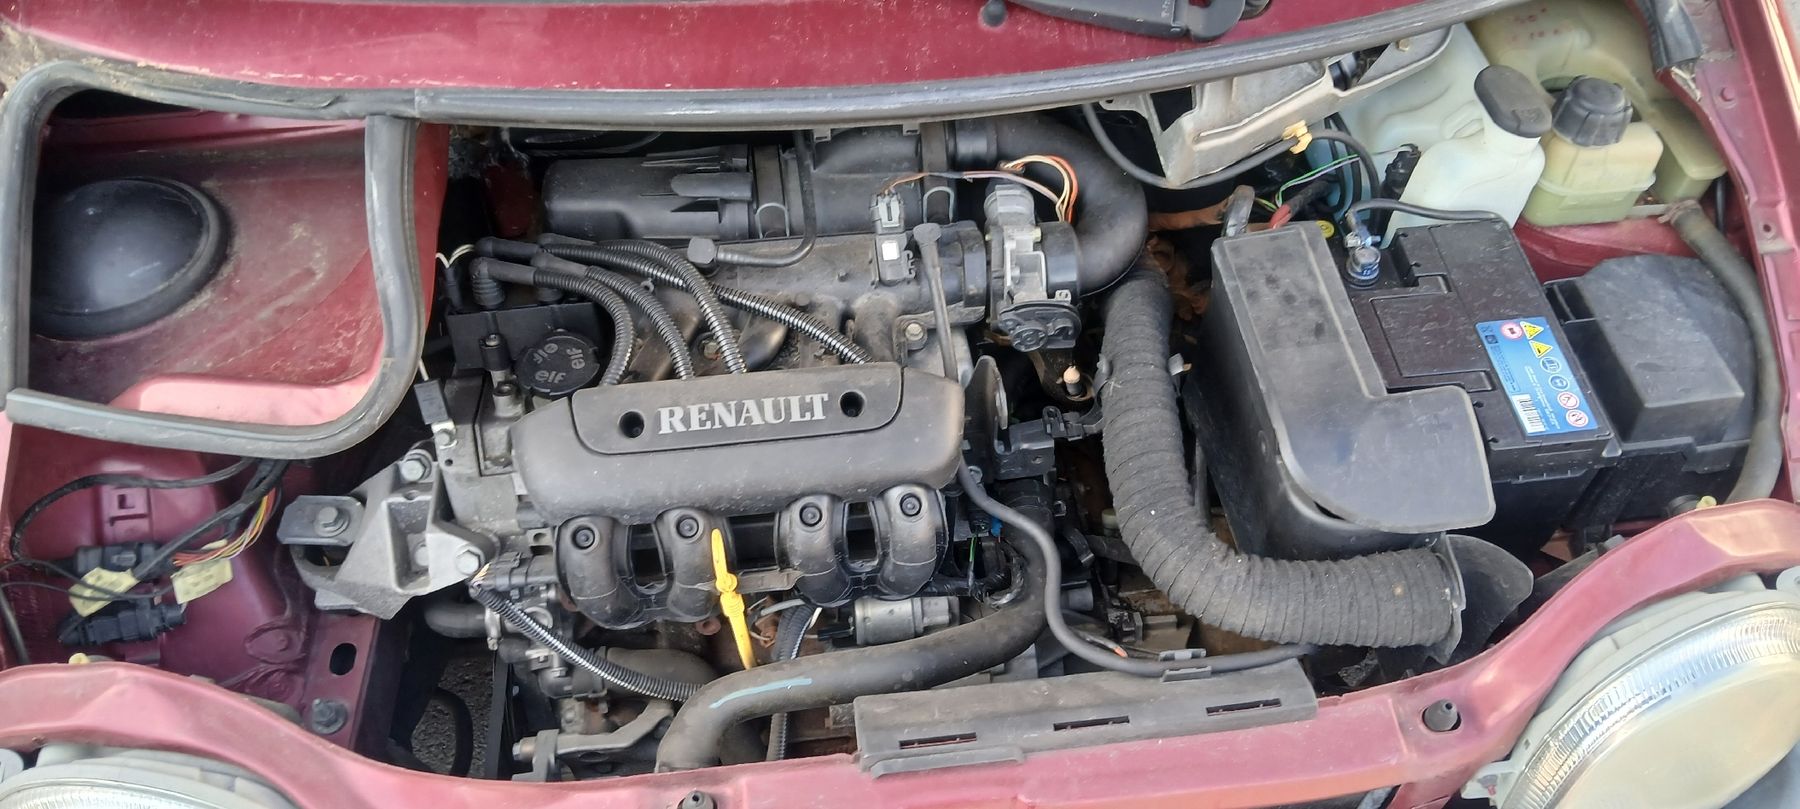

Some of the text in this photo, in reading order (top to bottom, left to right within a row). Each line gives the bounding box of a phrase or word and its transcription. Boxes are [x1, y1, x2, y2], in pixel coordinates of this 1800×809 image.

[566, 348, 585, 369] elf
[535, 370, 566, 383] elf
[657, 393, 828, 434] RENAULT
